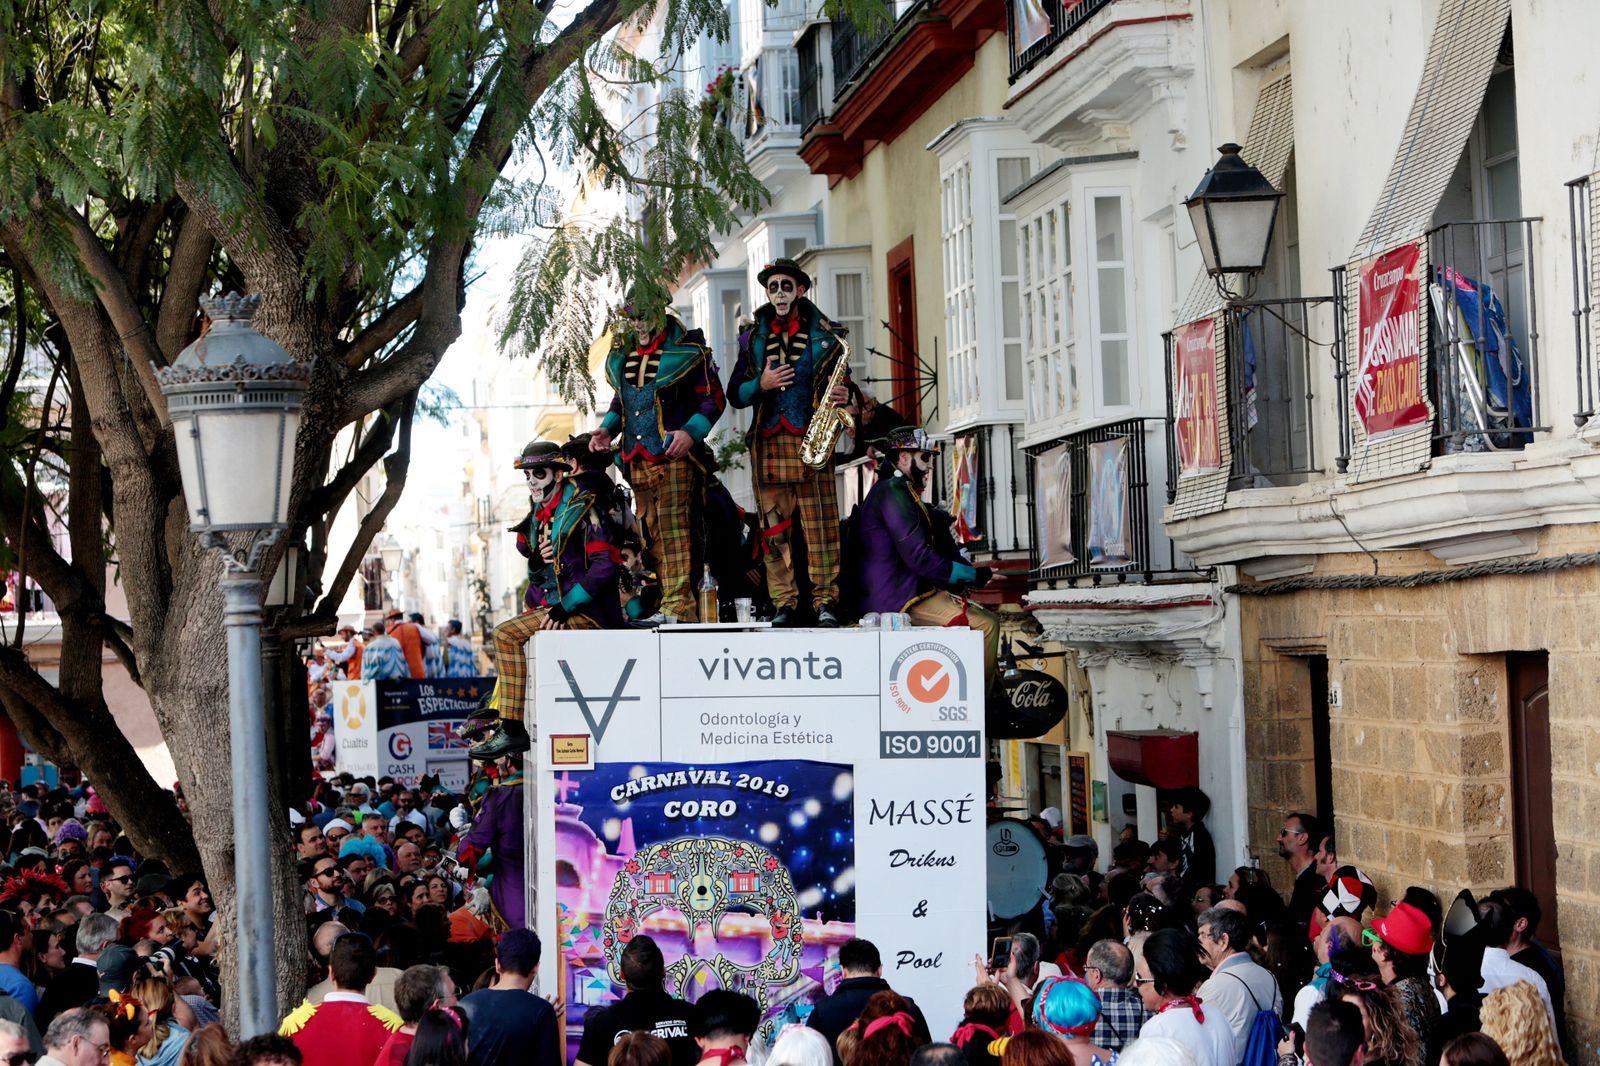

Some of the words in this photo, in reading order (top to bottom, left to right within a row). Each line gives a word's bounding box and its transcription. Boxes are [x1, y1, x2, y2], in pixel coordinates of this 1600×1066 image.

[1371, 310, 1419, 366] CARNAVAL
[898, 644, 918, 664] SYSTEM
[919, 642, 961, 664] CERTIFICATION
[698, 648, 842, 680] vivanta
[419, 684, 435, 697] LOS
[889, 682, 900, 698] ISO
[895, 697, 911, 714] 9001
[1011, 680, 1052, 708] Cola
[700, 712, 789, 728] Odontología
[793, 714, 802, 727] y
[938, 706, 967, 721] SGS
[342, 738, 369, 749] Cualtis
[701, 731, 768, 744] Medicina
[773, 731, 833, 744] Estética
[885, 735, 921, 754] ISO
[926, 735, 976, 754] 9001
[388, 764, 415, 775] CASH
[610, 770, 731, 801] CARNAVAL
[735, 773, 790, 798] 2019
[663, 800, 737, 818] CORO
[869, 793, 974, 826] MASSÉ
[889, 849, 956, 868] Drikns
[912, 899, 928, 918] &
[896, 950, 943, 970] Pool
